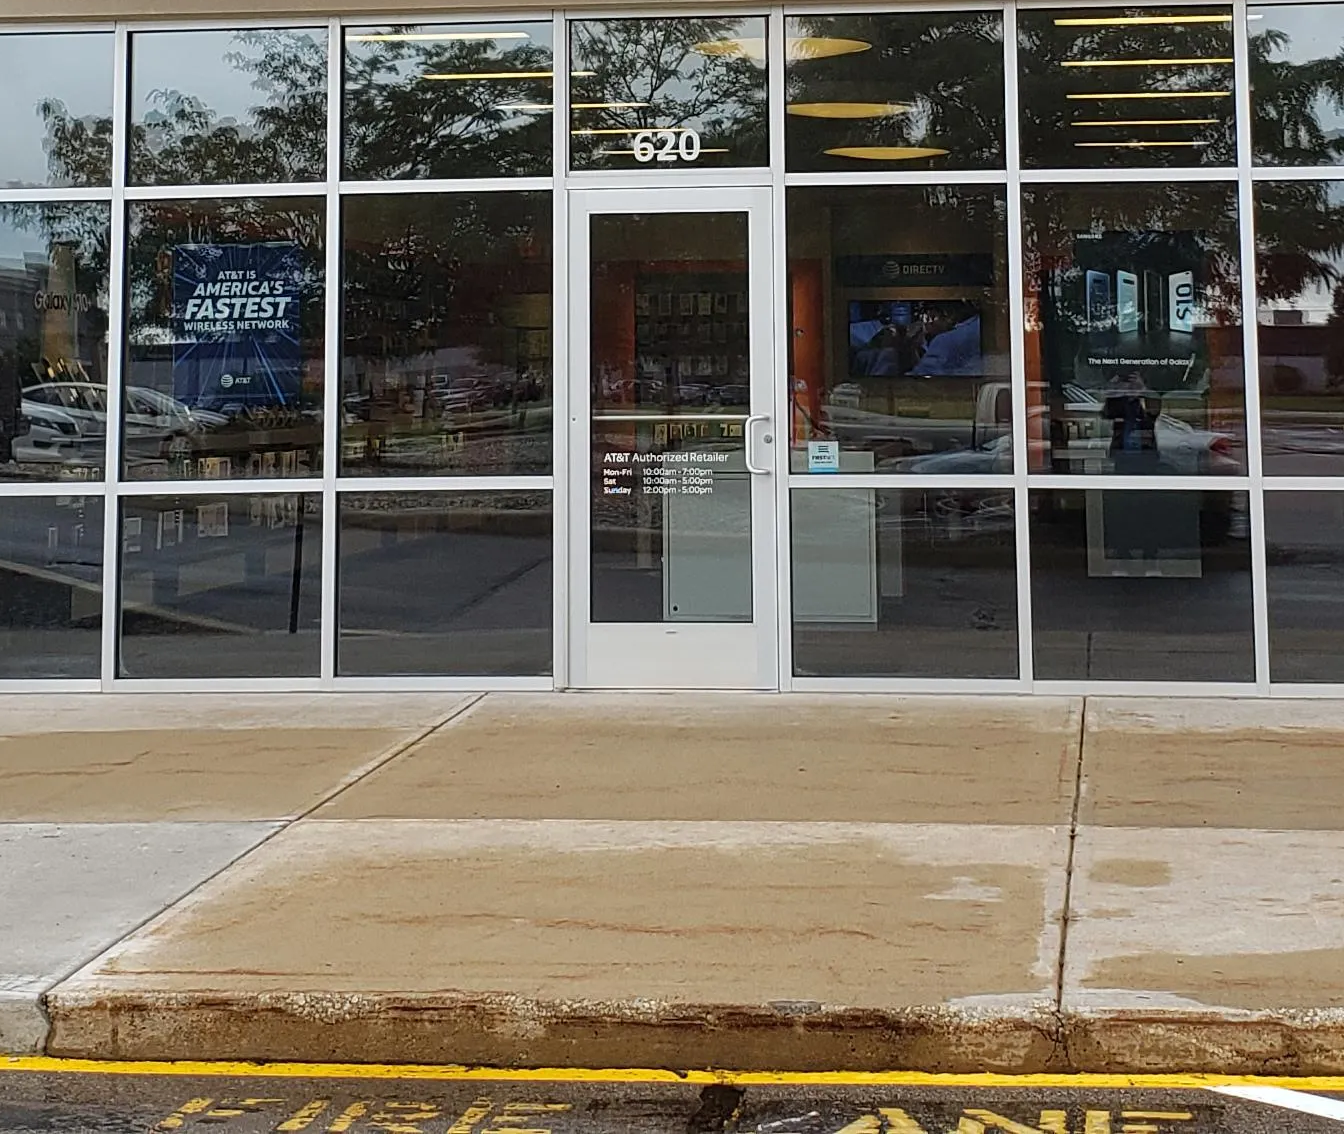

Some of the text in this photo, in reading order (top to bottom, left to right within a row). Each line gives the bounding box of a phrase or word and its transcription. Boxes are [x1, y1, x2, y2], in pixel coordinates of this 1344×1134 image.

[633, 128, 701, 163] 620
[217, 270, 256, 280] AT&T IS
[902, 265, 945, 275] DIRECTV
[193, 280, 284, 297] AMERICA'S
[1175, 282, 1193, 321] S10
[184, 296, 292, 320] FASTEST
[183, 319, 290, 332] WIRELESS NETWORK
[1088, 357, 1102, 365] The
[1119, 357, 1159, 365] Generation
[1160, 357, 1169, 365] of
[234, 376, 251, 384] AT&T
[603, 452, 729, 463] AT&T Authorized Retailer
[603, 468, 633, 476] Mon-Fri
[642, 467, 677, 476] 10:00am
[682, 467, 713, 477] 7:00pm
[603, 477, 617, 486] Sat
[642, 477, 677, 486] 10:00am
[682, 477, 713, 486] 5:00pm
[603, 486, 632, 495] Sunday
[642, 486, 677, 495] 12:00pm
[682, 486, 713, 495] 5:00pm
[159, 1097, 574, 1134] FIRE
[756, 1104, 1194, 1134] ANE
